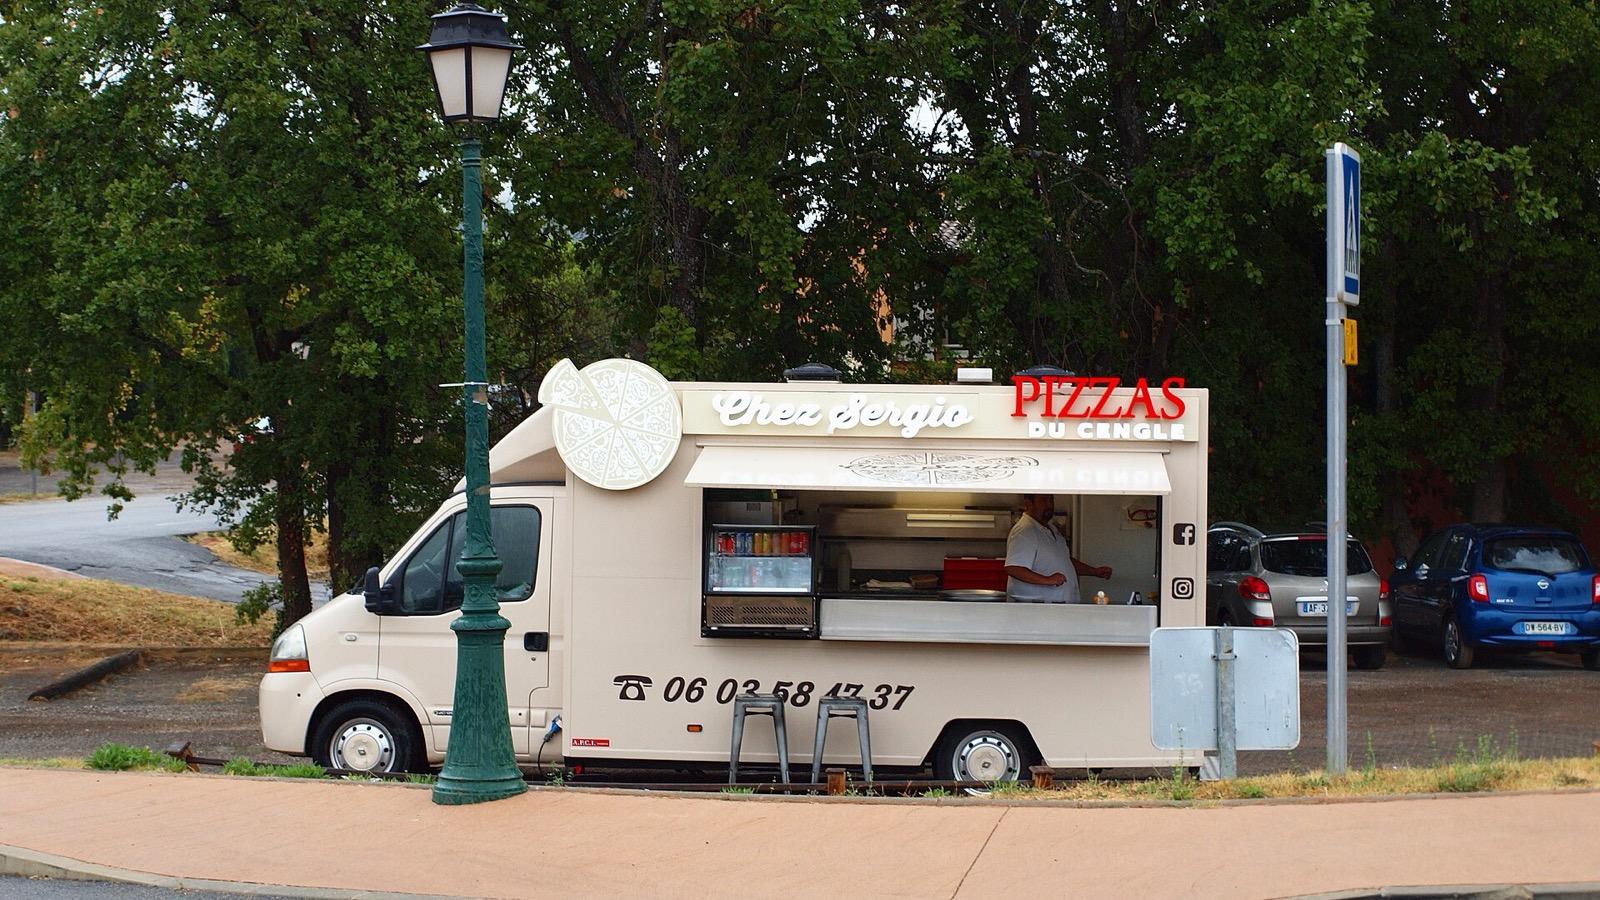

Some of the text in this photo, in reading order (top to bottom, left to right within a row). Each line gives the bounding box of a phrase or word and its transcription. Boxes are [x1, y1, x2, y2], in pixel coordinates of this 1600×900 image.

[712, 391, 974, 438] Chez Sergio
[1011, 375, 1186, 420] PIZZAS
[1028, 422, 1185, 440] DU CENGLE
[663, 676, 708, 703] 06
[716, 678, 761, 705] 03
[771, 680, 815, 708] 58
[869, 684, 915, 711] 37
